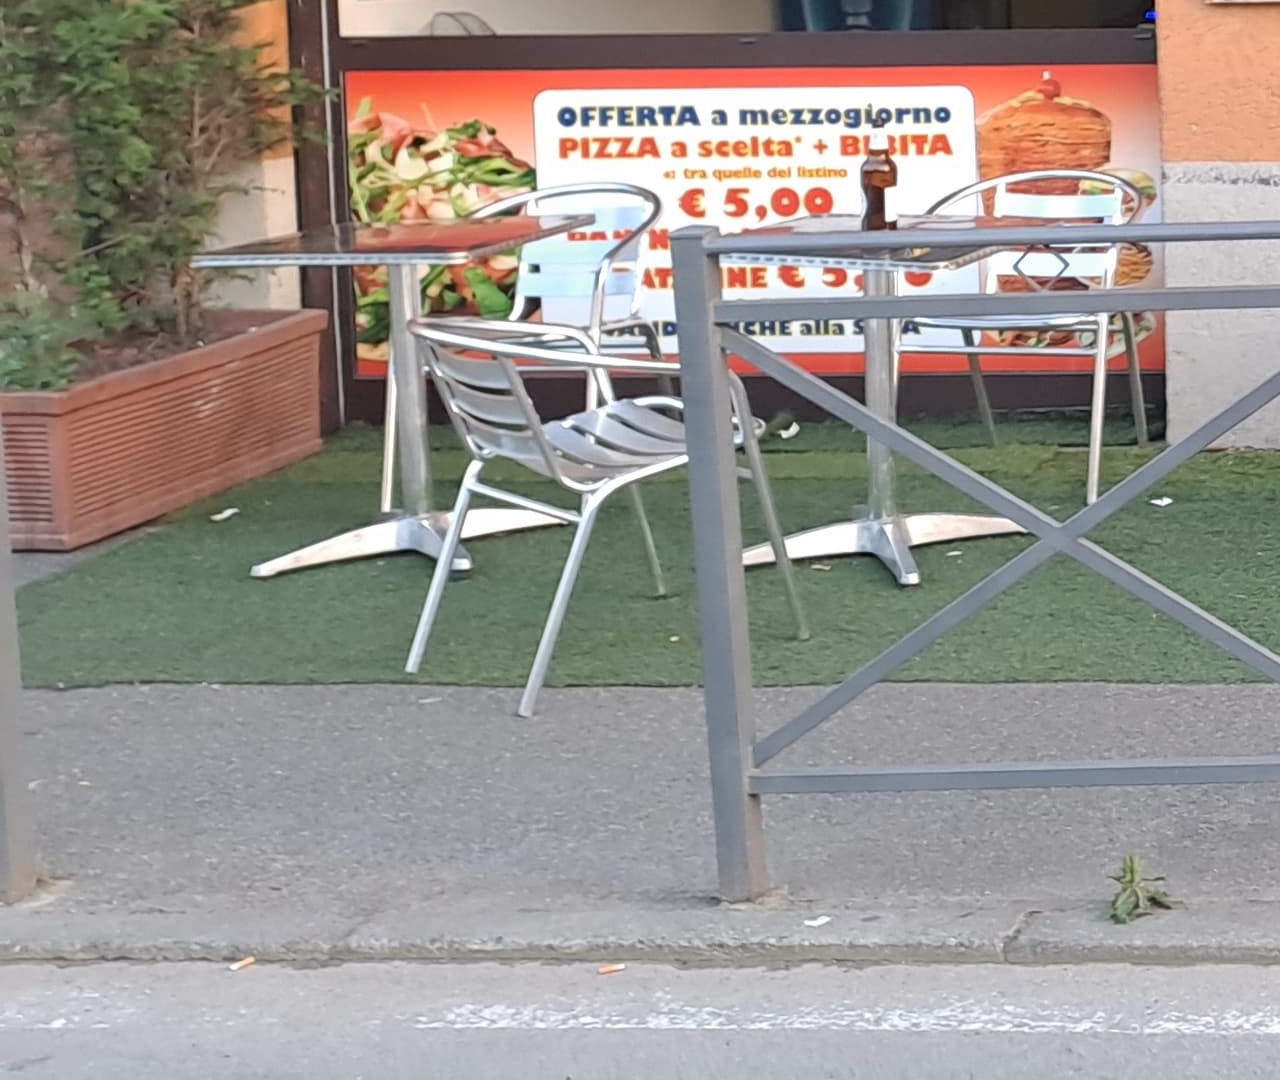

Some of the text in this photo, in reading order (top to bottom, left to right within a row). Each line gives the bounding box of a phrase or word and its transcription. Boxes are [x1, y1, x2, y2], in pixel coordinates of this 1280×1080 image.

[557, 104, 951, 129] OFFERTA a mezzogiorno
[558, 136, 661, 159] PIZZA
[670, 140, 688, 158] a
[683, 168, 708, 180] tra
[712, 167, 762, 183] quelle
[797, 166, 848, 180] listino
[678, 186, 834, 223] € 5,00
[799, 321, 844, 336] alla
[852, 321, 921, 336] SA
